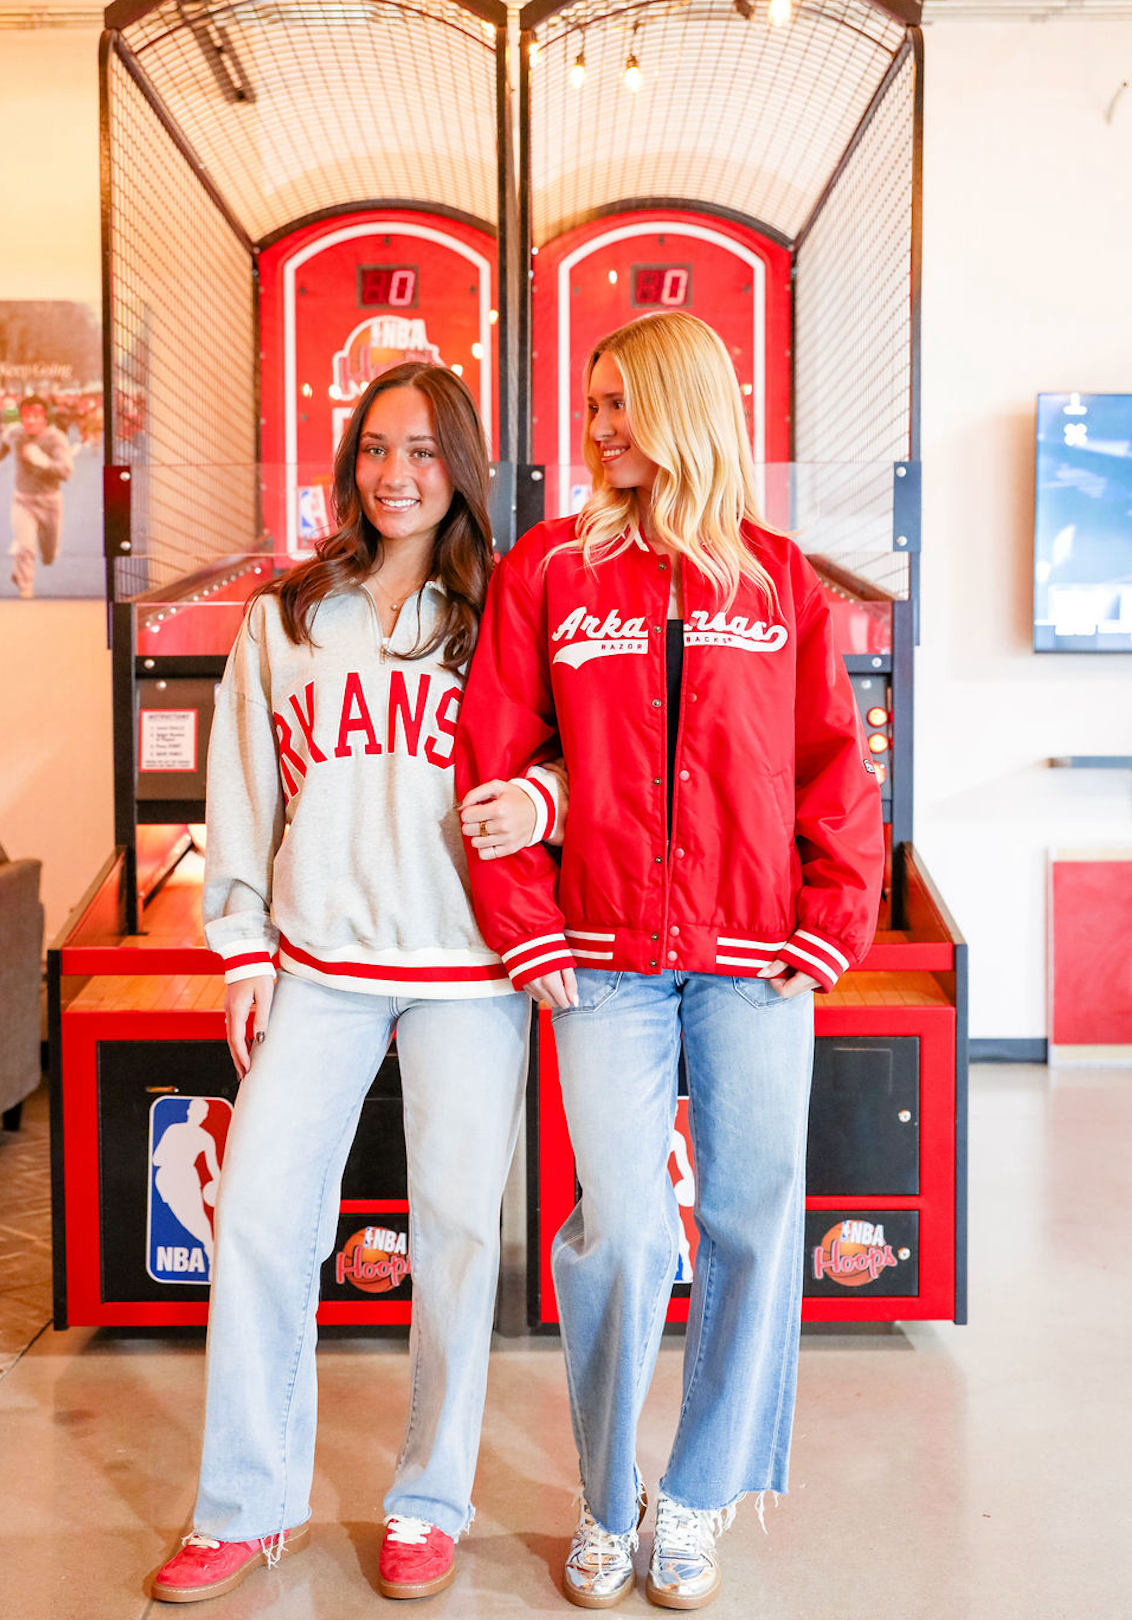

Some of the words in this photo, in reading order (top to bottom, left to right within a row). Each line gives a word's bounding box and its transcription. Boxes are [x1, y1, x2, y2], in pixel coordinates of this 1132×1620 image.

[388, 270, 416, 306] 0
[661, 269, 688, 306] 0
[373, 1228, 407, 1255] NBA
[851, 1221, 884, 1247] NBA
[156, 1246, 206, 1273] NBA
[814, 1239, 898, 1279] Hoops
